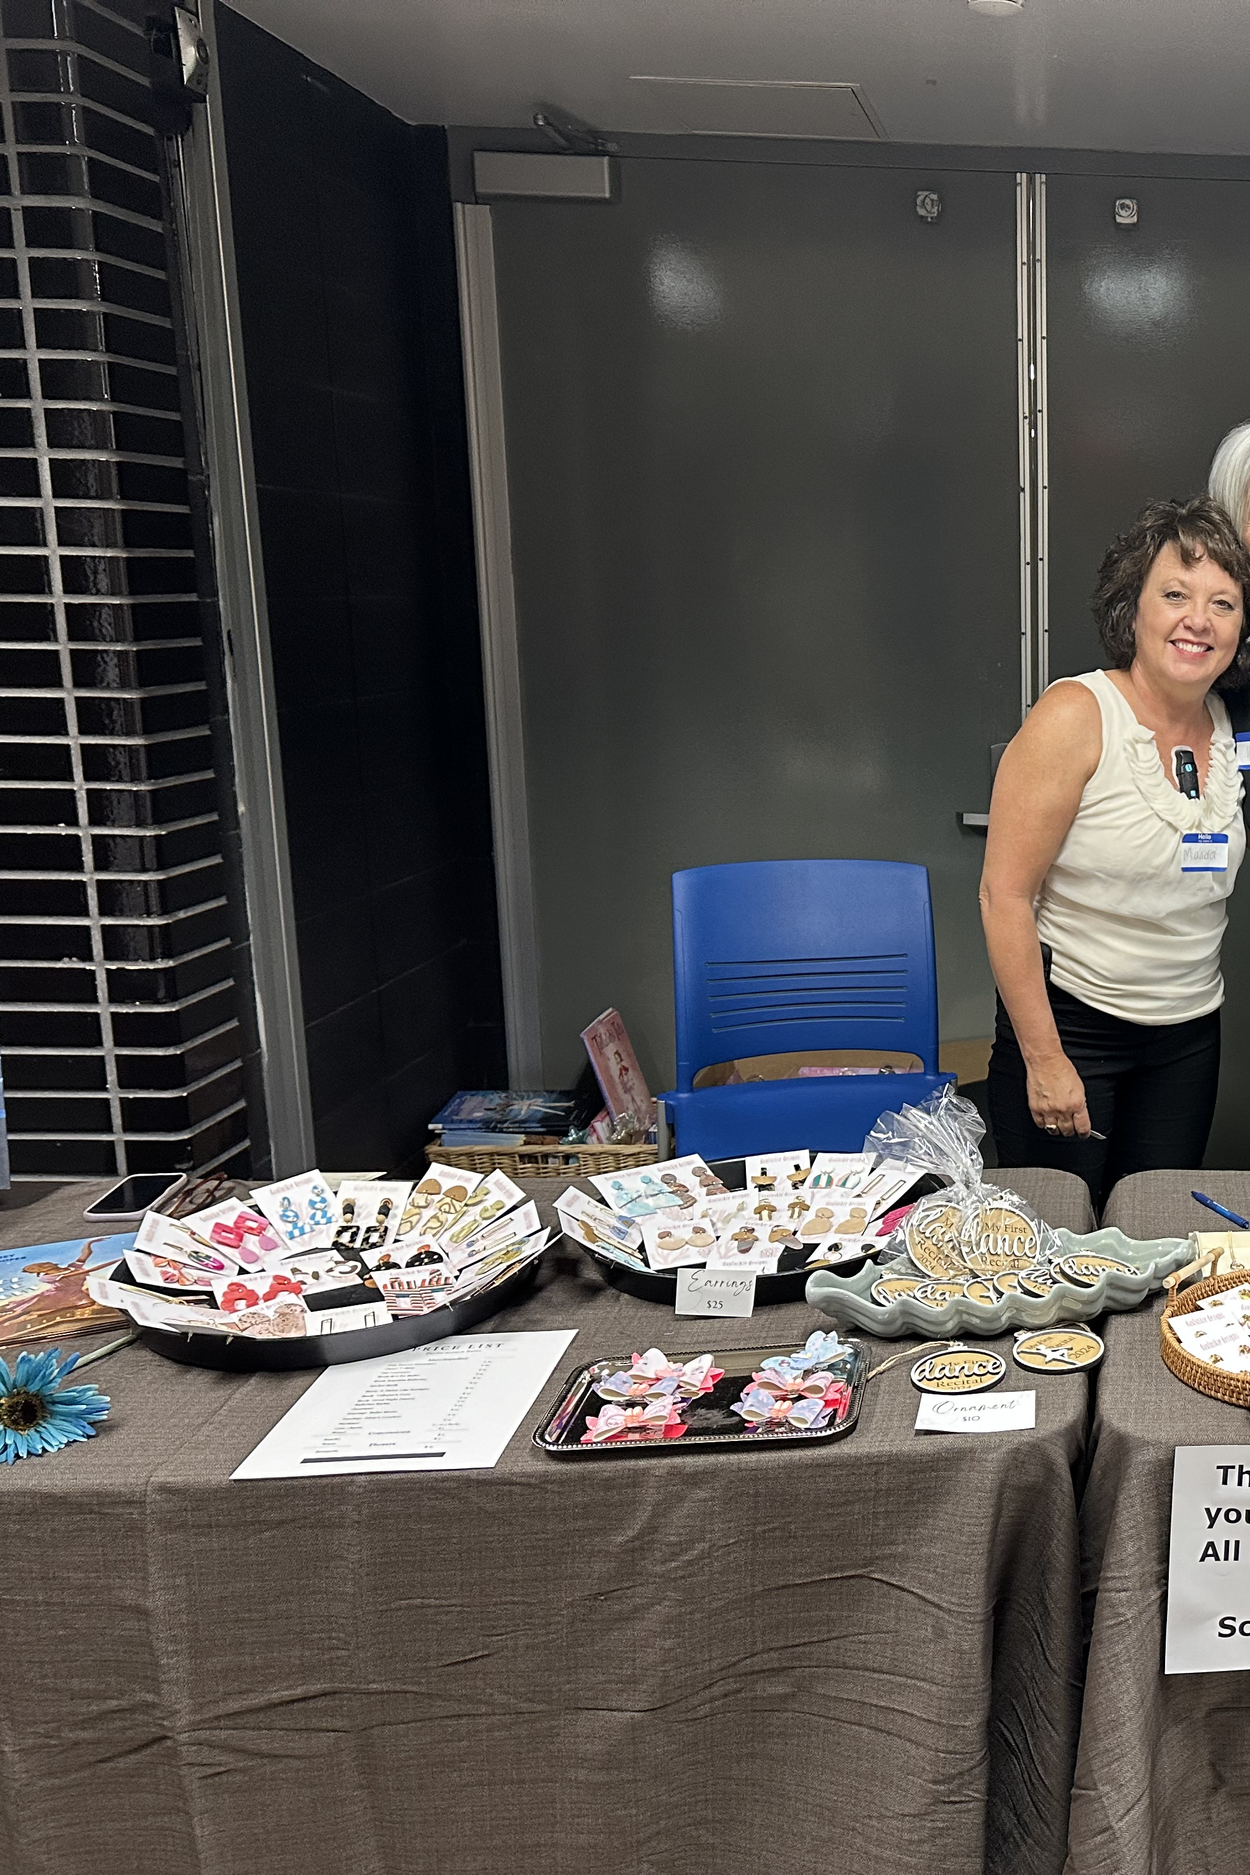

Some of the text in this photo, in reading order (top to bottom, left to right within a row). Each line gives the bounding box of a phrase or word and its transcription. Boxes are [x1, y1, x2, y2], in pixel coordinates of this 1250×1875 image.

[984, 1222, 1028, 1234] My First
[688, 1269, 753, 1296] Earrings
[706, 1300, 724, 1310] $25
[412, 1345, 461, 1353] PRICE
[1069, 1345, 1095, 1359] 2024
[915, 1360, 1003, 1382] dance
[936, 1377, 983, 1388] Recital
[932, 1399, 1017, 1415] Ornament
[1199, 1539, 1240, 1563] All
